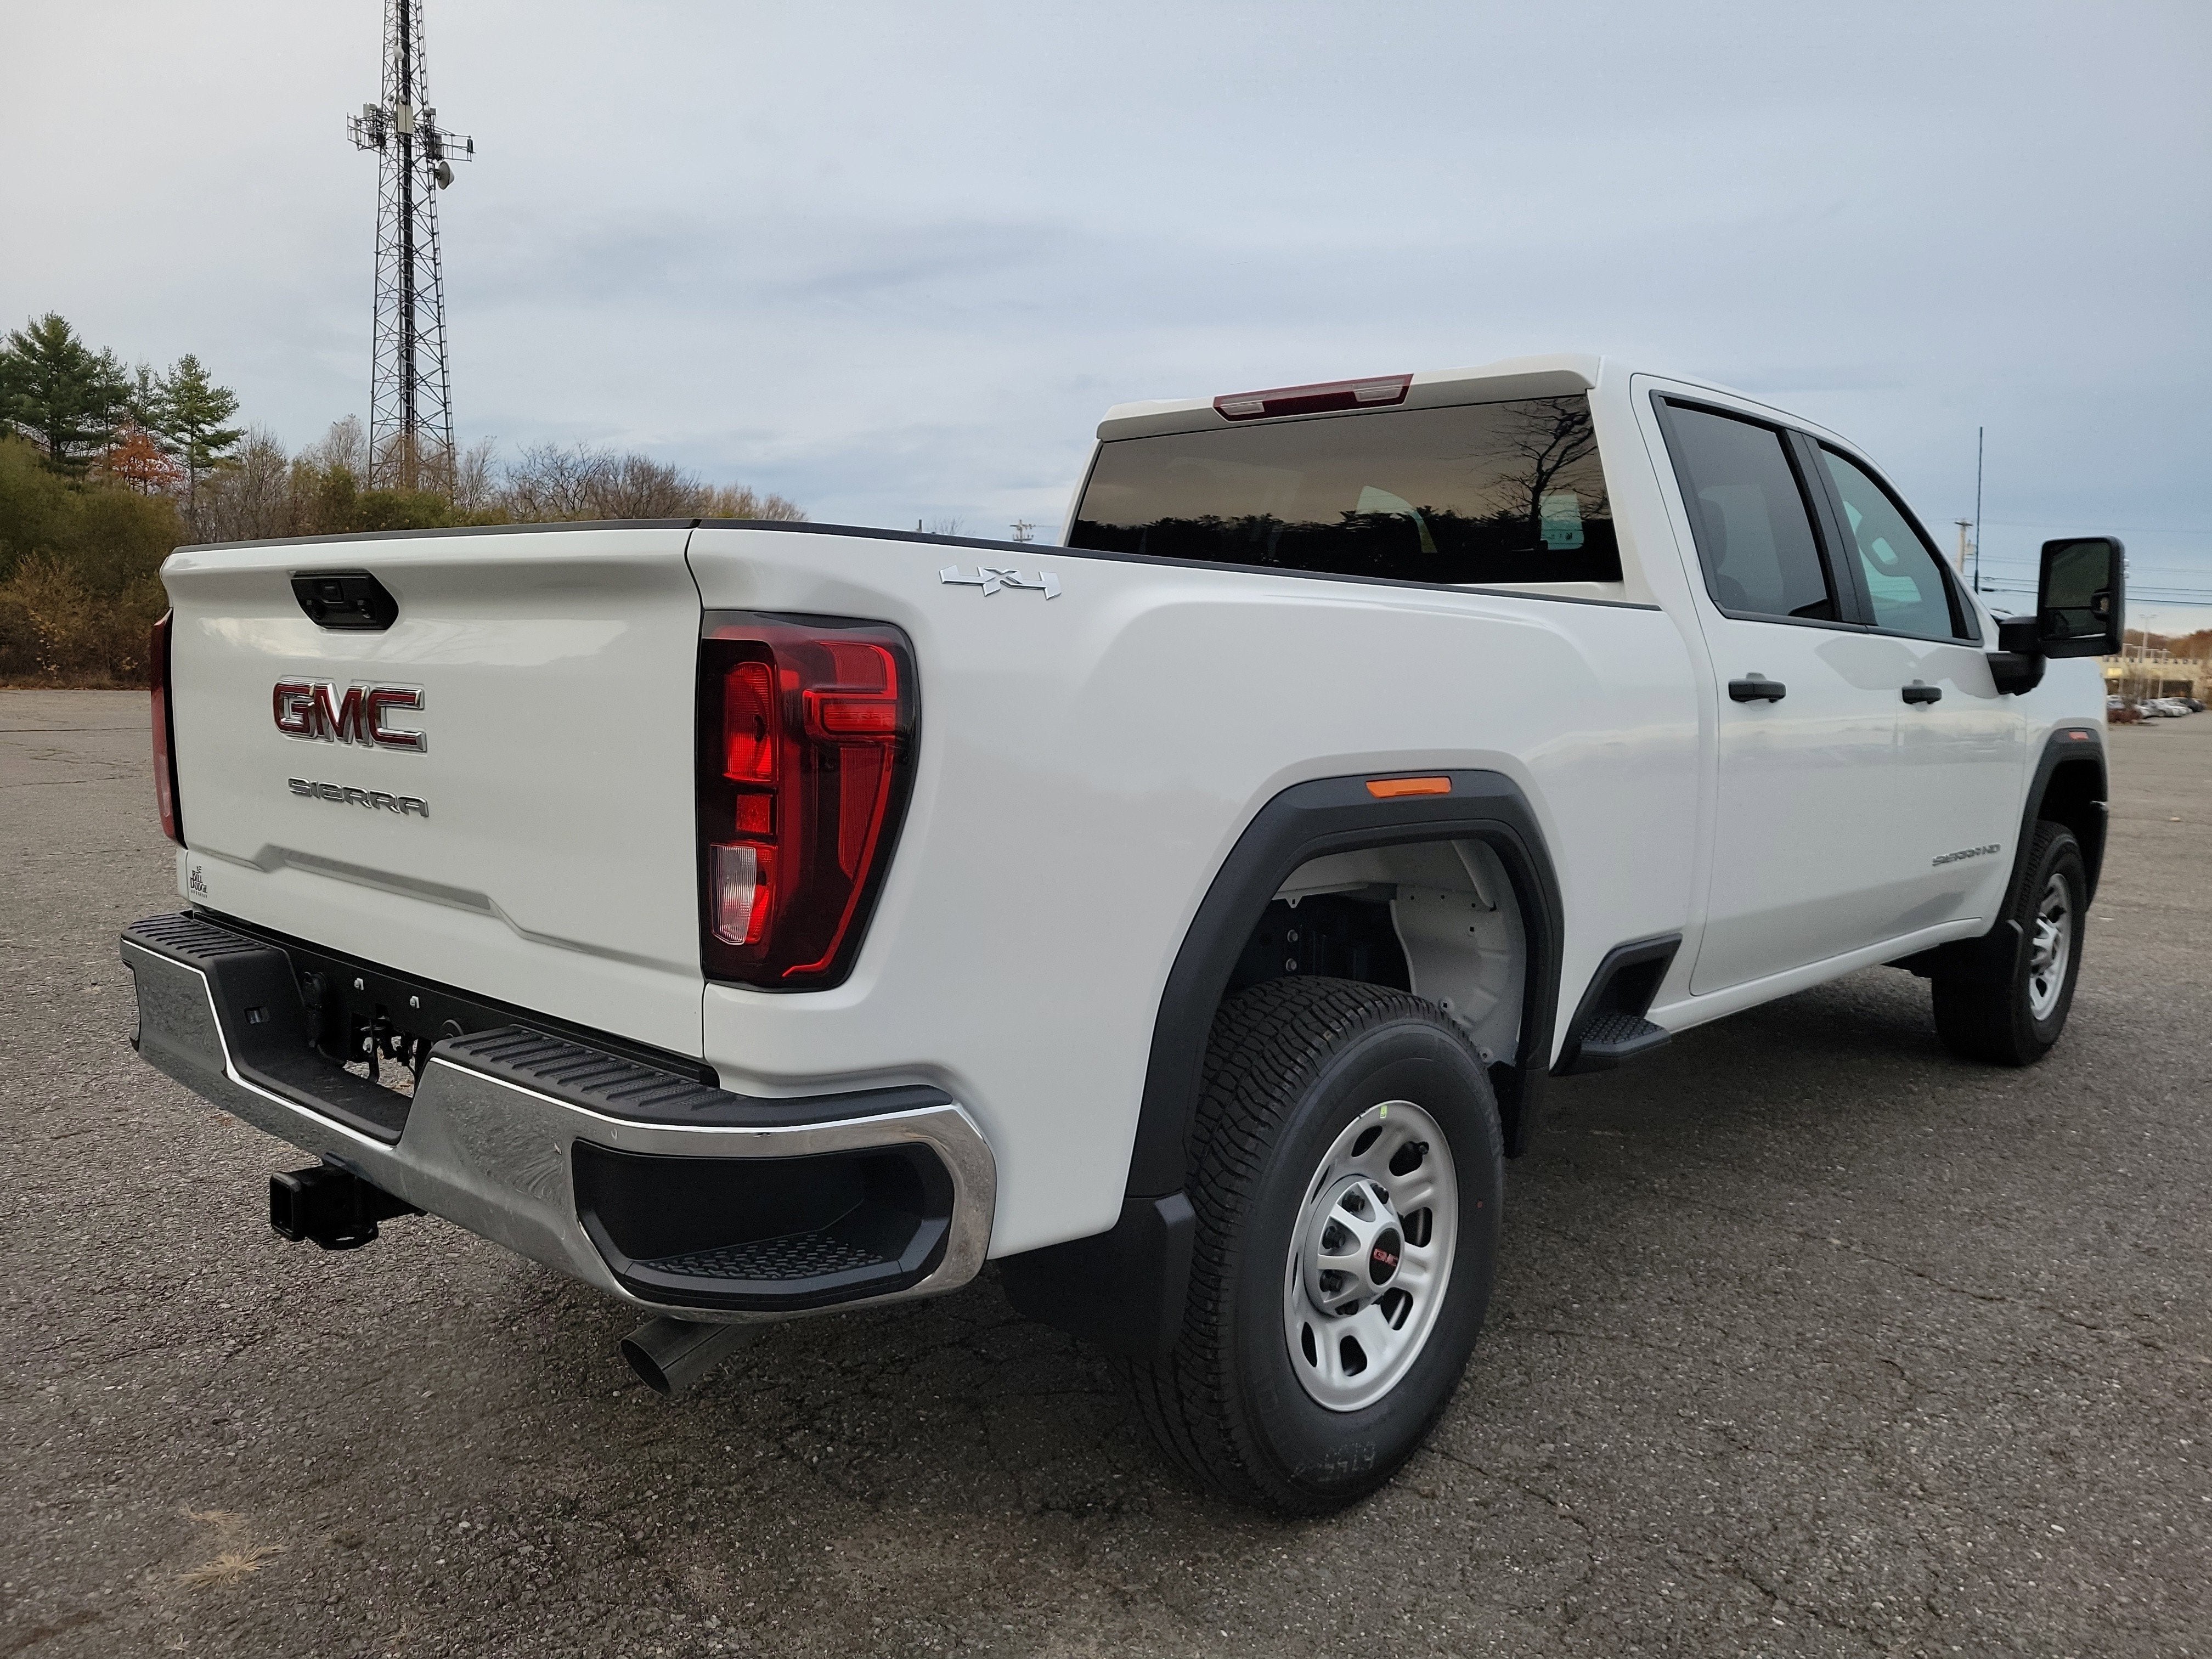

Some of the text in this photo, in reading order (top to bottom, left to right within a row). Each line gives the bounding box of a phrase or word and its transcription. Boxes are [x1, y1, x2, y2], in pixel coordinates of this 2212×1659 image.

[273, 680, 427, 752] GMC
[287, 777, 430, 817] SIERRA
[190, 877, 207, 894] DODGE
[192, 870, 203, 884] BILL
